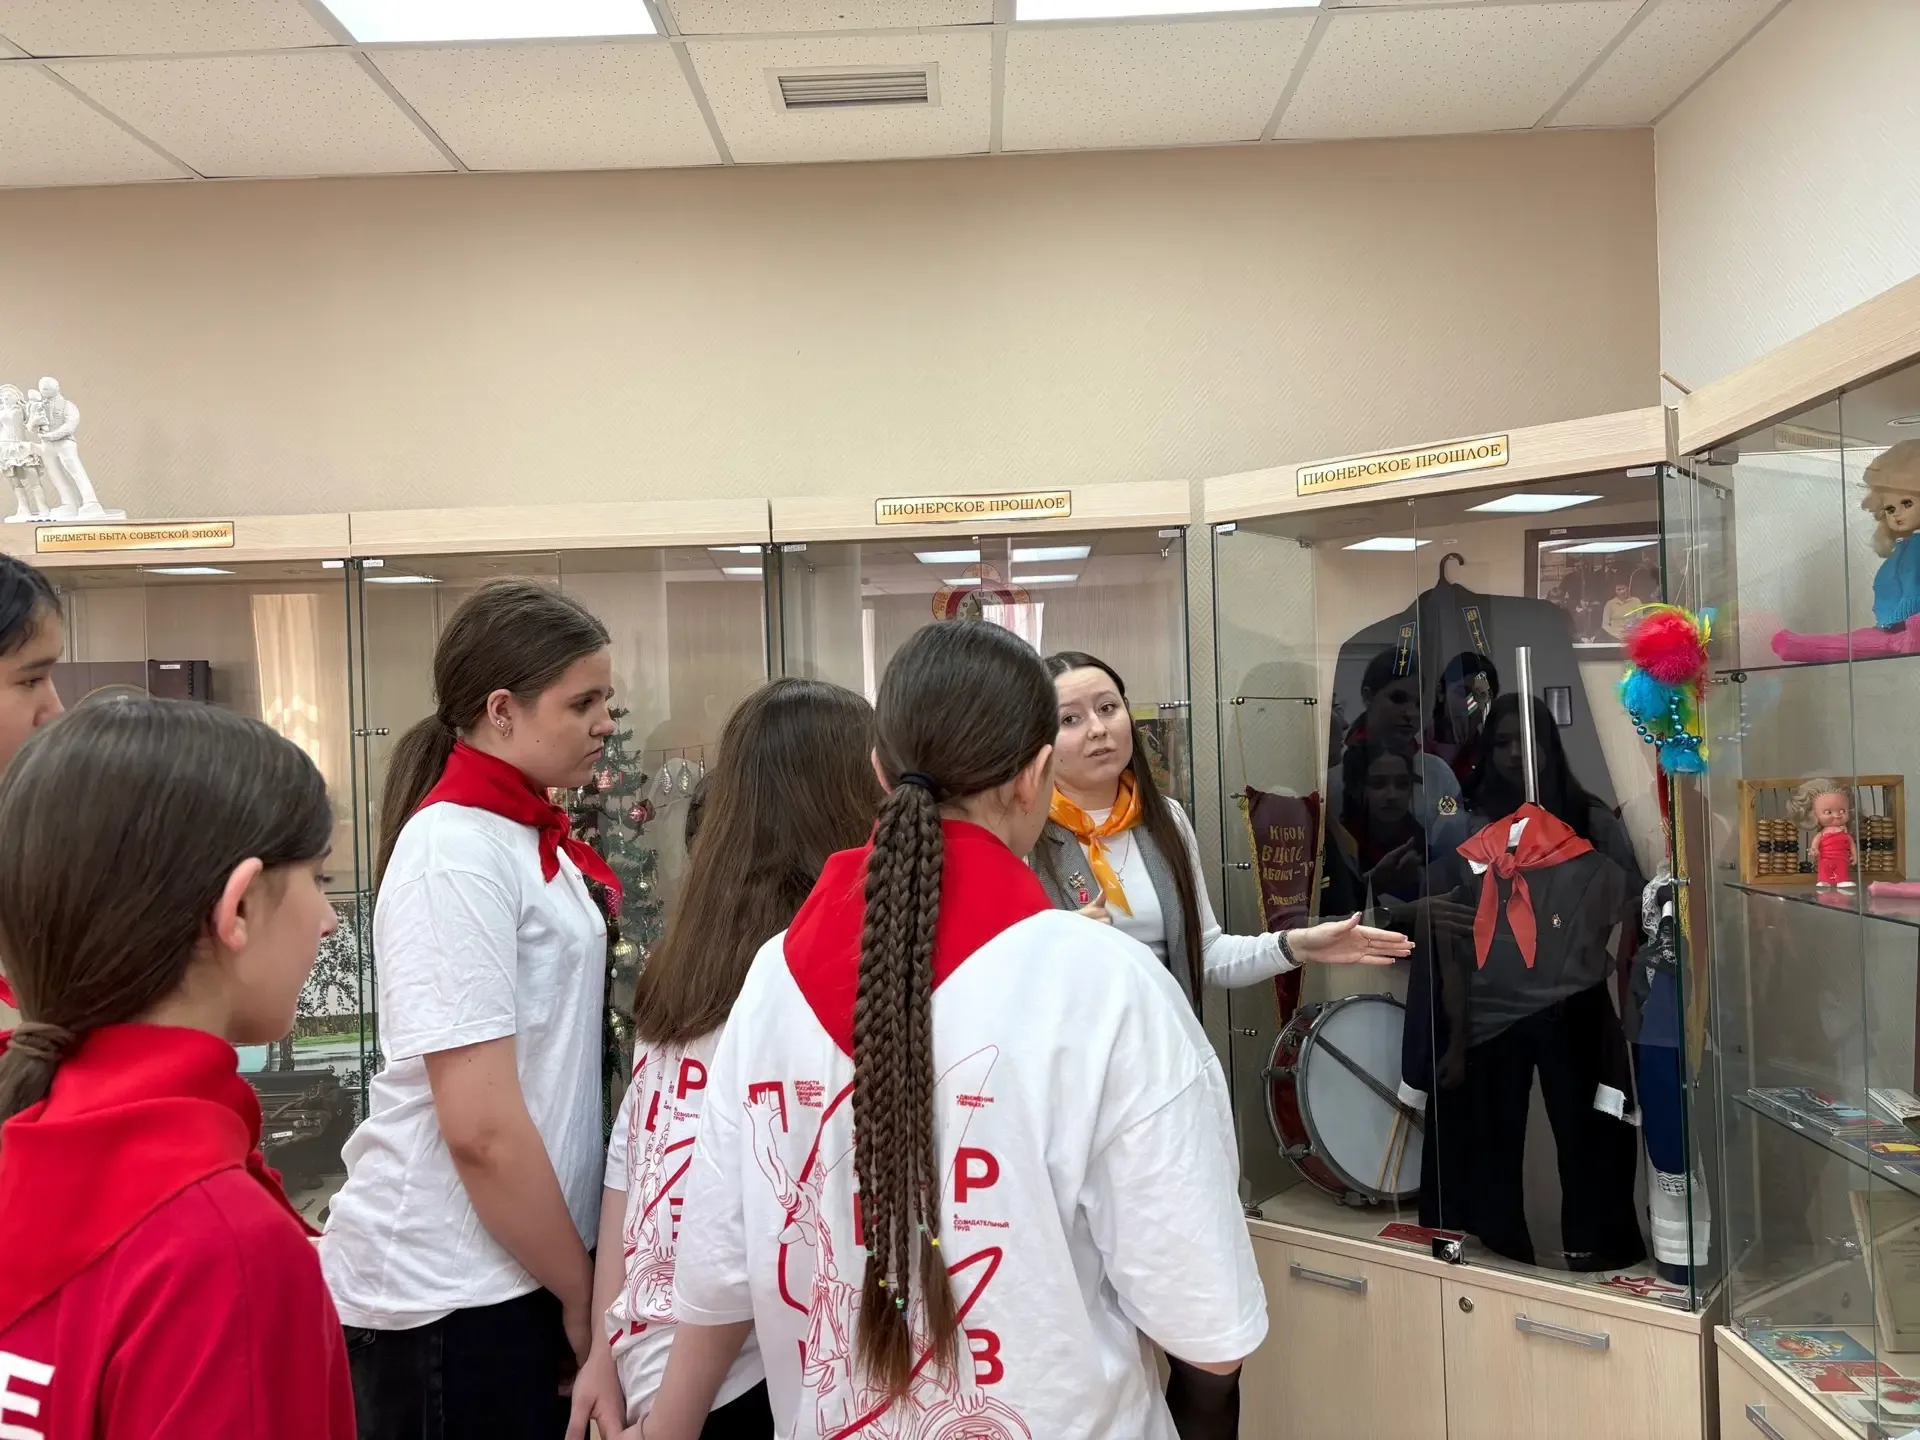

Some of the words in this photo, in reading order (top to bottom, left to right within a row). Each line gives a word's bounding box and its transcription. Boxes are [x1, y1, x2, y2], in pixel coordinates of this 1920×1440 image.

[1303, 458, 1411, 486] ПИОНЕРСКОЕ
[1416, 443, 1502, 469] ПРОШЛОЕ
[882, 500, 985, 516] ПИОНЕРСКОЕ
[989, 497, 1065, 512] ПРОШЛОЕ
[42, 533, 96, 543] ПРЕДМЕТЫ
[99, 532, 128, 541] БЫТА
[129, 529, 189, 540] СОВЕТСКОЙ
[192, 529, 227, 538] ЭПОХИ
[953, 1219, 1010, 1229] СОЗИДАТЕЛЬНЫЙ
